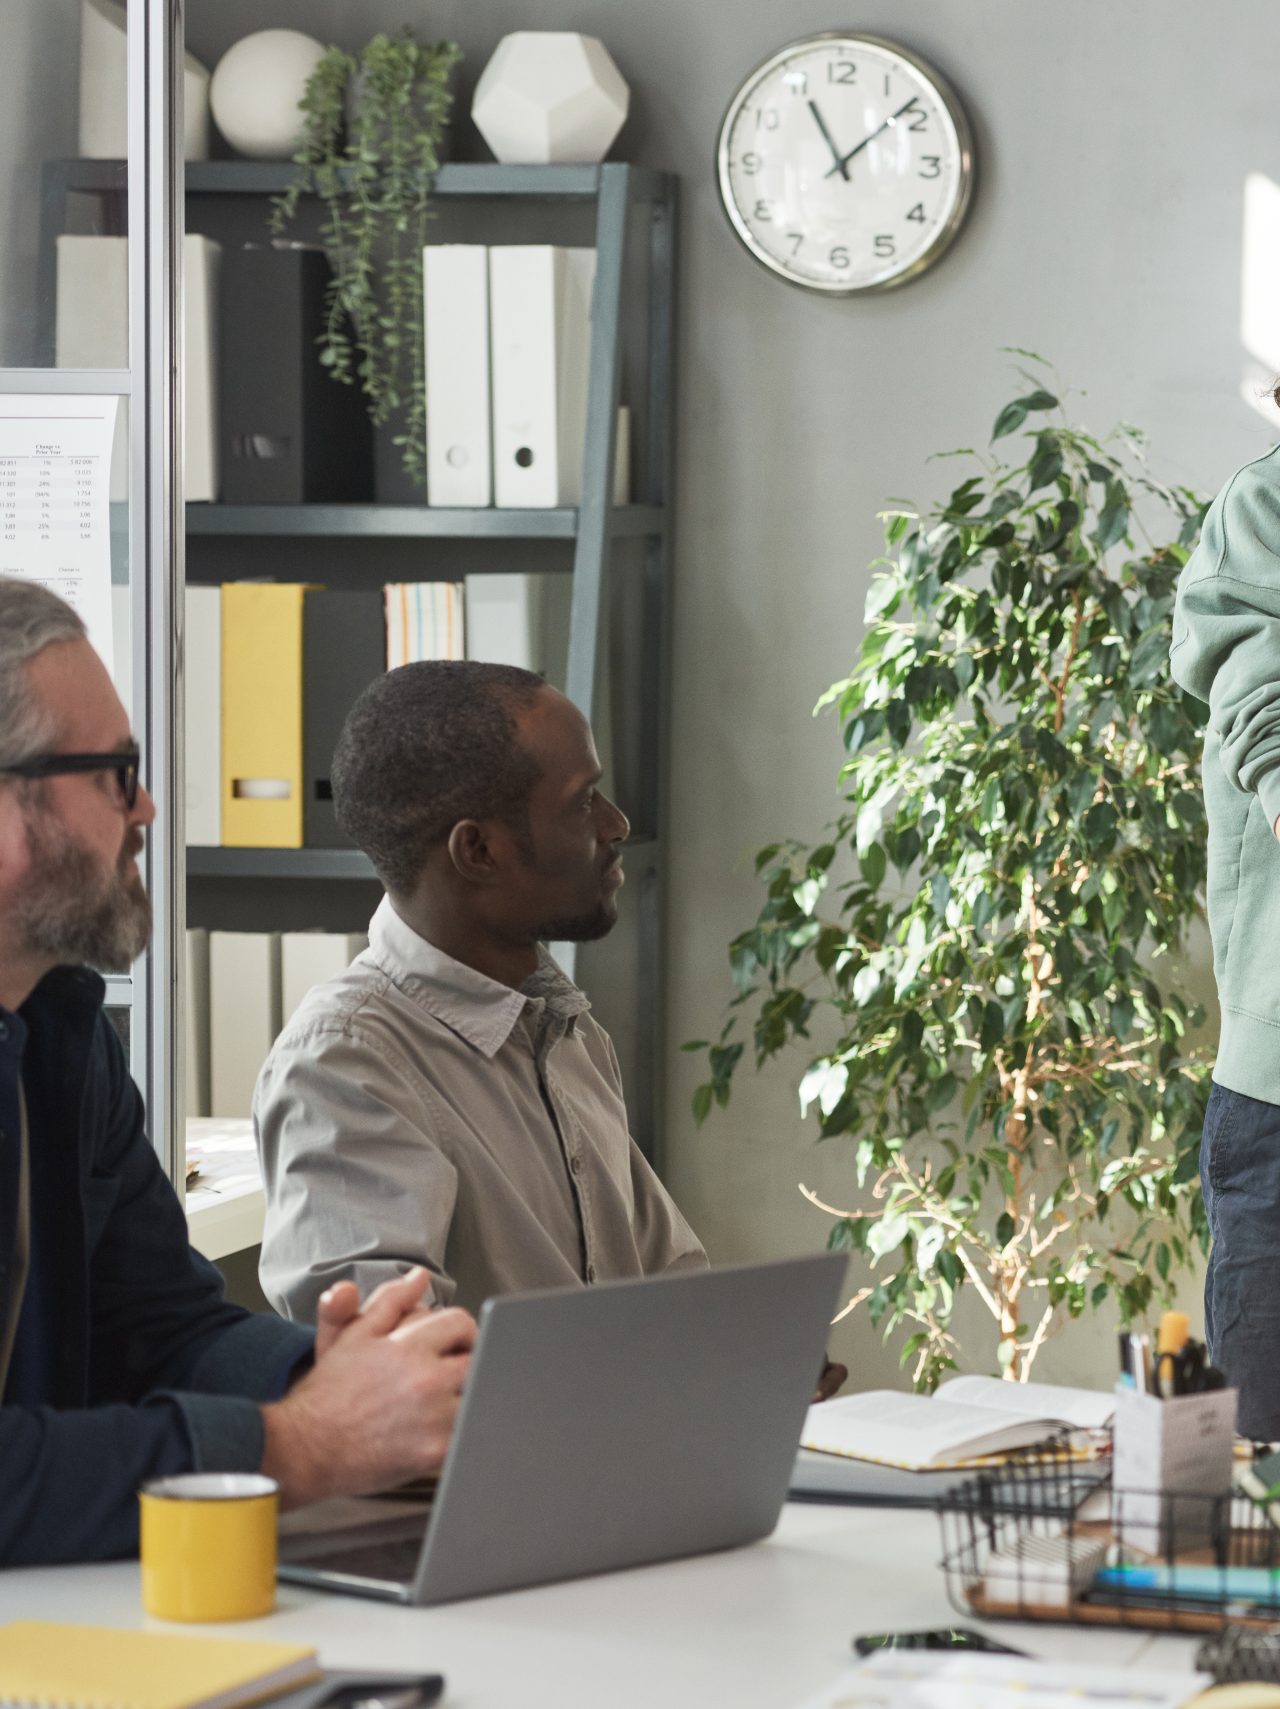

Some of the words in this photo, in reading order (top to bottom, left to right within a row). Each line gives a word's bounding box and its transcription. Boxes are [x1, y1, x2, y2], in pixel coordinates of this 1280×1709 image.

[827, 62, 856, 84] 12
[884, 74, 889, 96] 1
[755, 108, 779, 131] 10
[908, 107, 928, 132] 2
[742, 153, 762, 175] 9
[918, 156, 941, 179] 3
[906, 202, 927, 223] 4
[786, 233, 804, 256] 7
[874, 235, 896, 257] 5
[829, 246, 850, 268] 6
